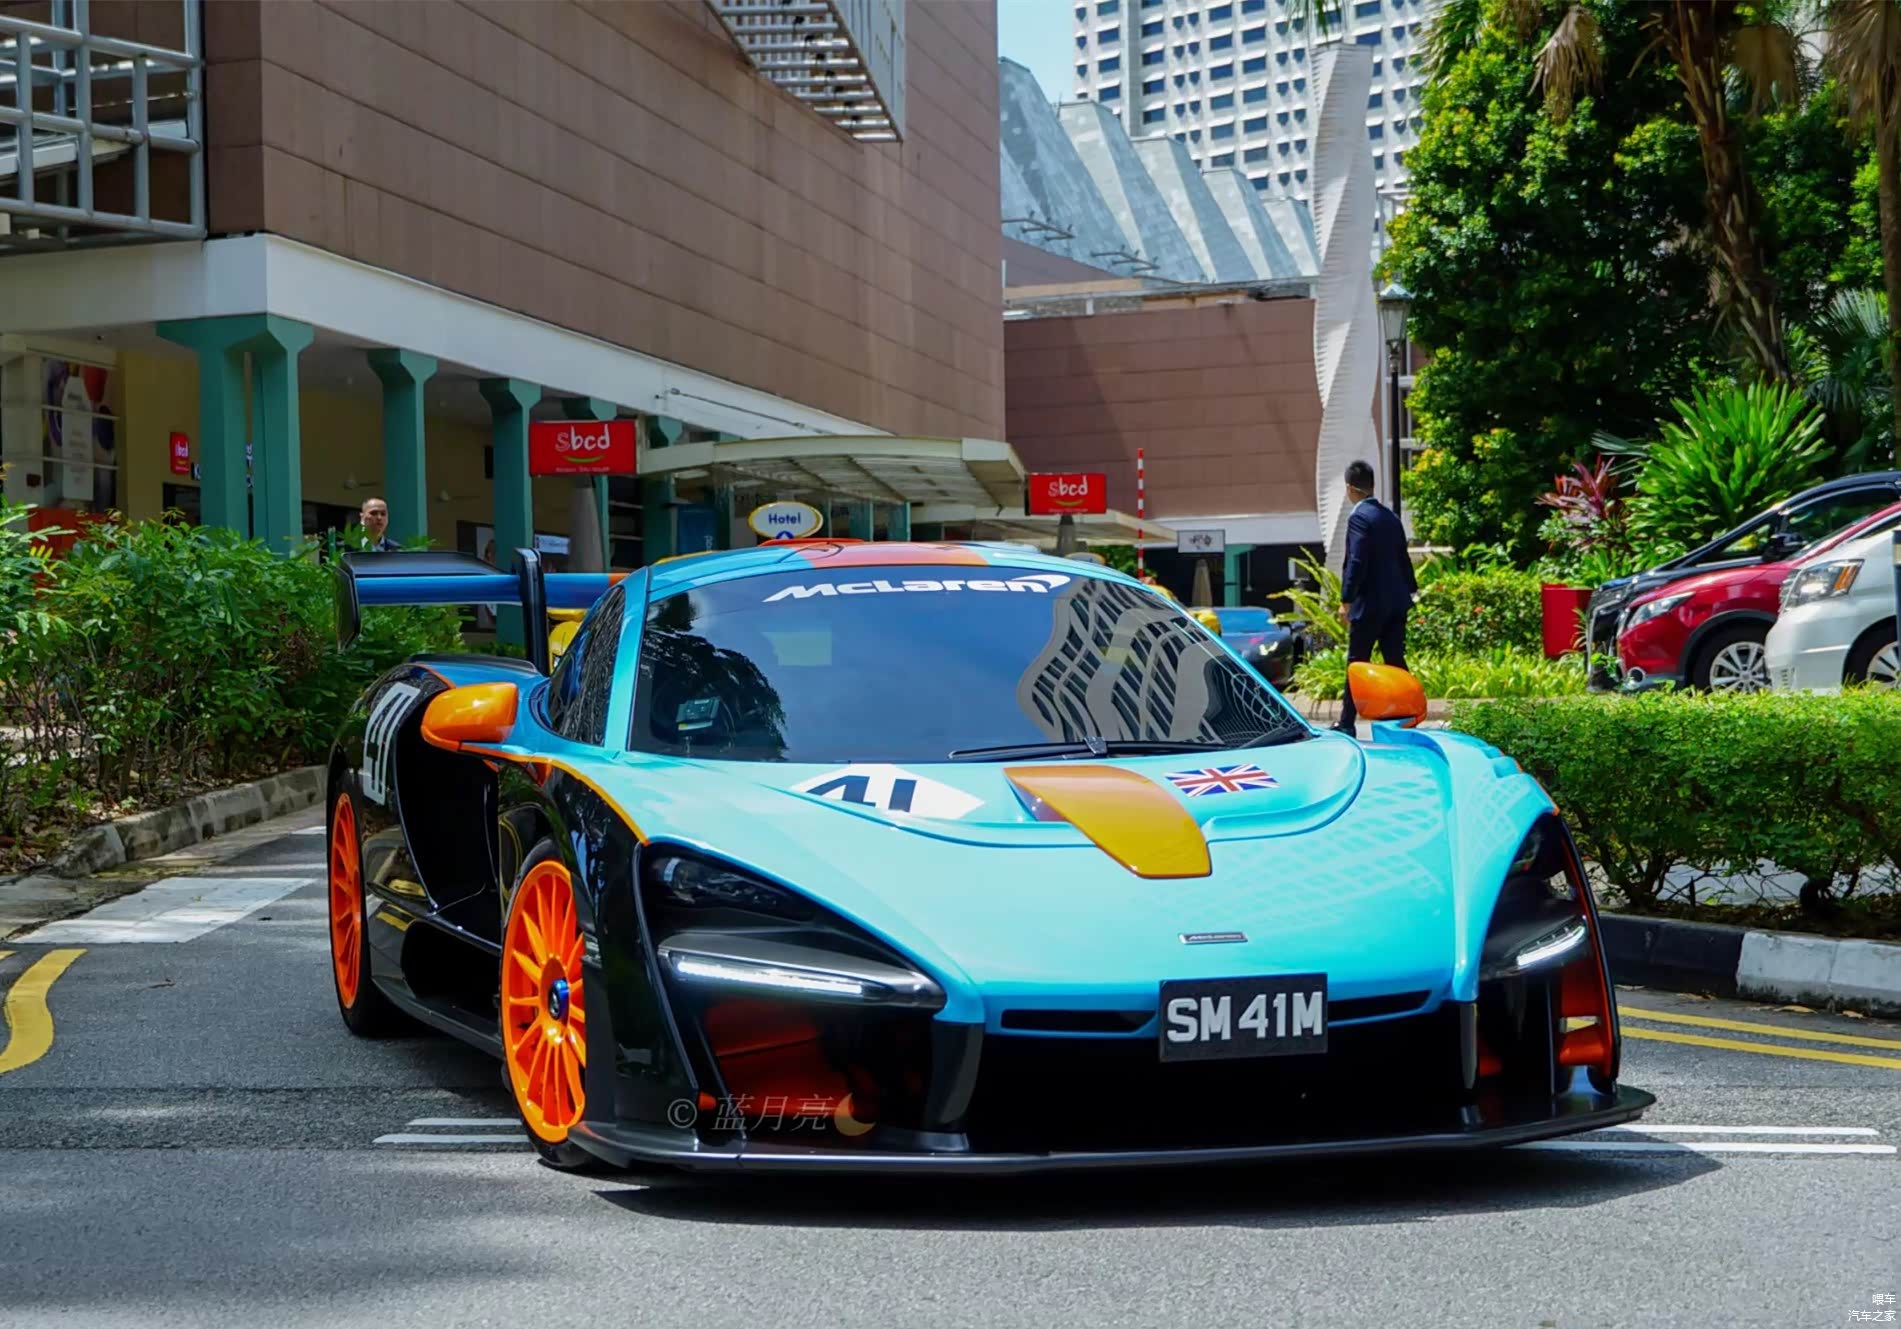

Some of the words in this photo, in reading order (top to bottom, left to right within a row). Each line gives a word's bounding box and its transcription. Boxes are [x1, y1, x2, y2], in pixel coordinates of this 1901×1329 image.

[555, 423, 610, 452] sbcd
[1048, 475, 1088, 497] sbcd
[768, 512, 802, 525] Hotel
[762, 574, 1071, 603] McLaren
[805, 774, 918, 813] 41
[1166, 995, 1232, 1043] SM
[1238, 991, 1324, 1039] 41M
